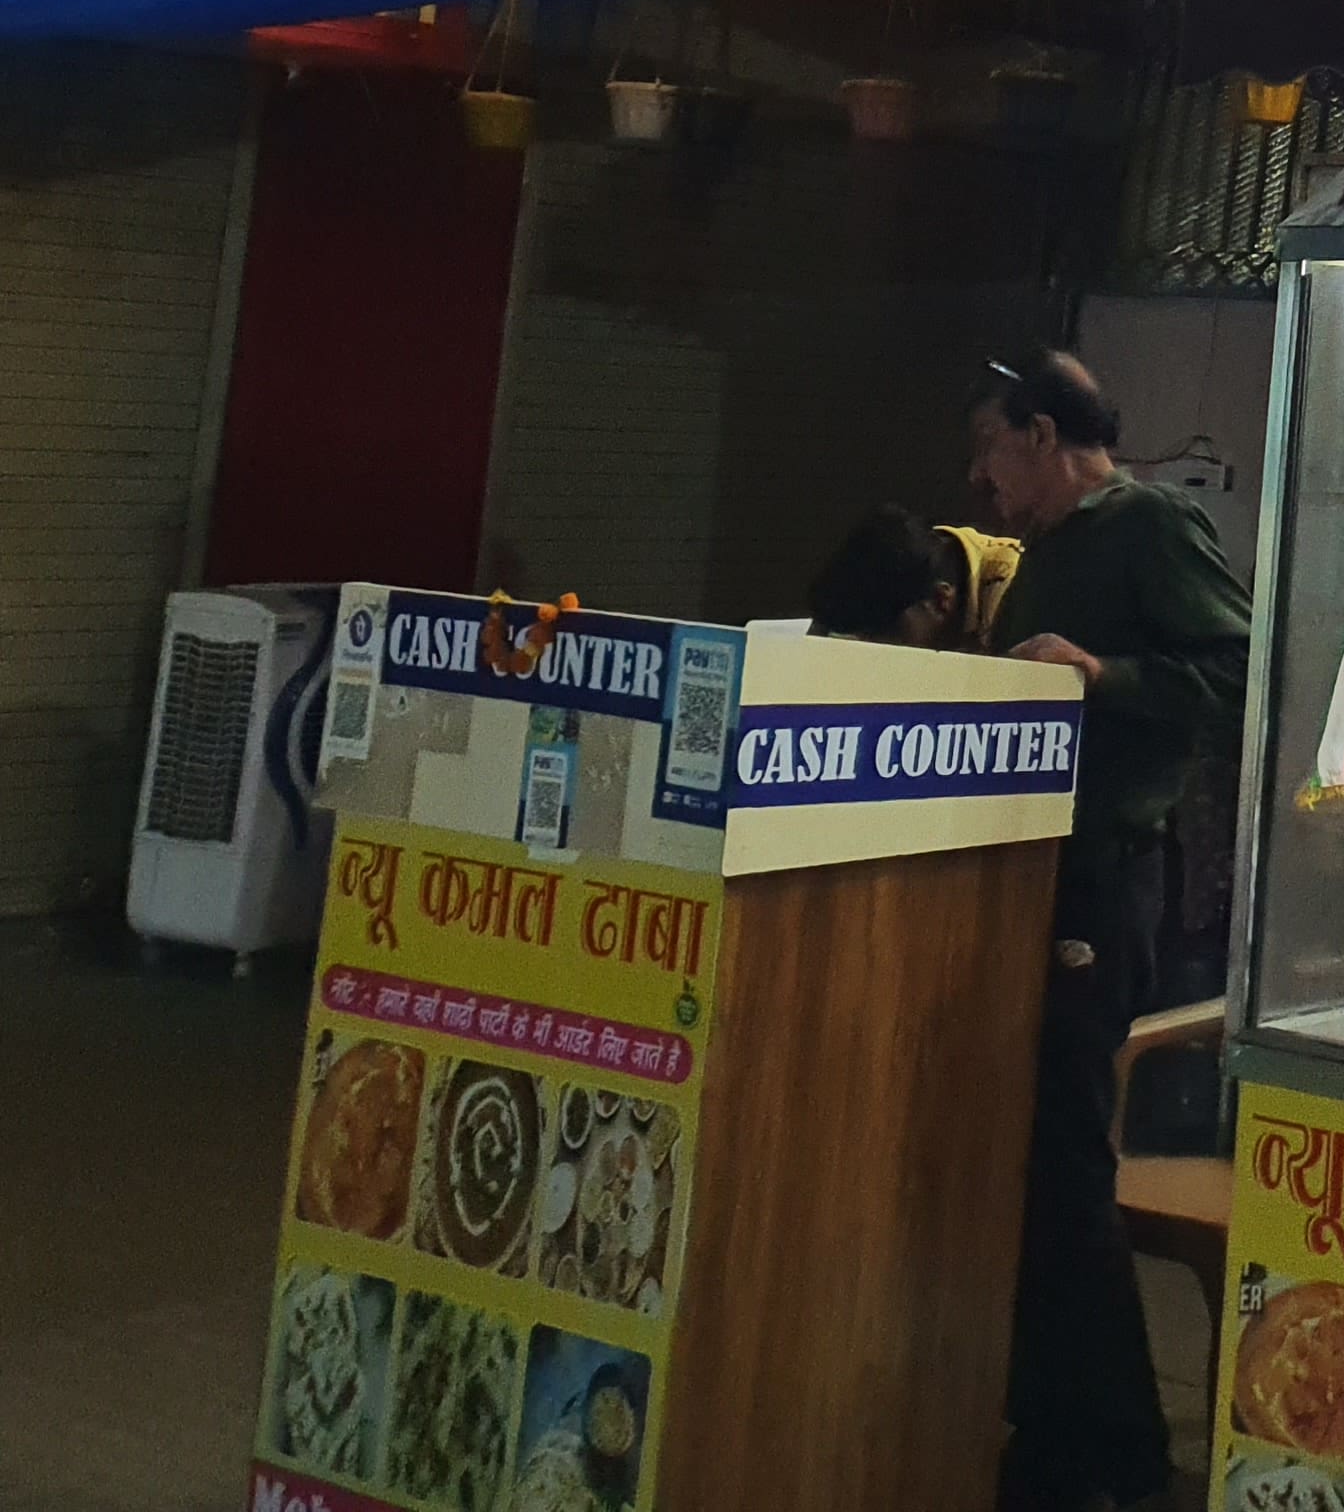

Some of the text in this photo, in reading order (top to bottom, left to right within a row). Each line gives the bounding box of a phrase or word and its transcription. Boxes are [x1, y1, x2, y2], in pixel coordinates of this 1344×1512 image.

[388, 613, 481, 673] CASH
[737, 719, 1070, 786] CASH COUNTER
[337, 838, 709, 977] न्यू कमल ढाबा
[512, 1008, 530, 1041] के
[533, 1014, 553, 1048] भी
